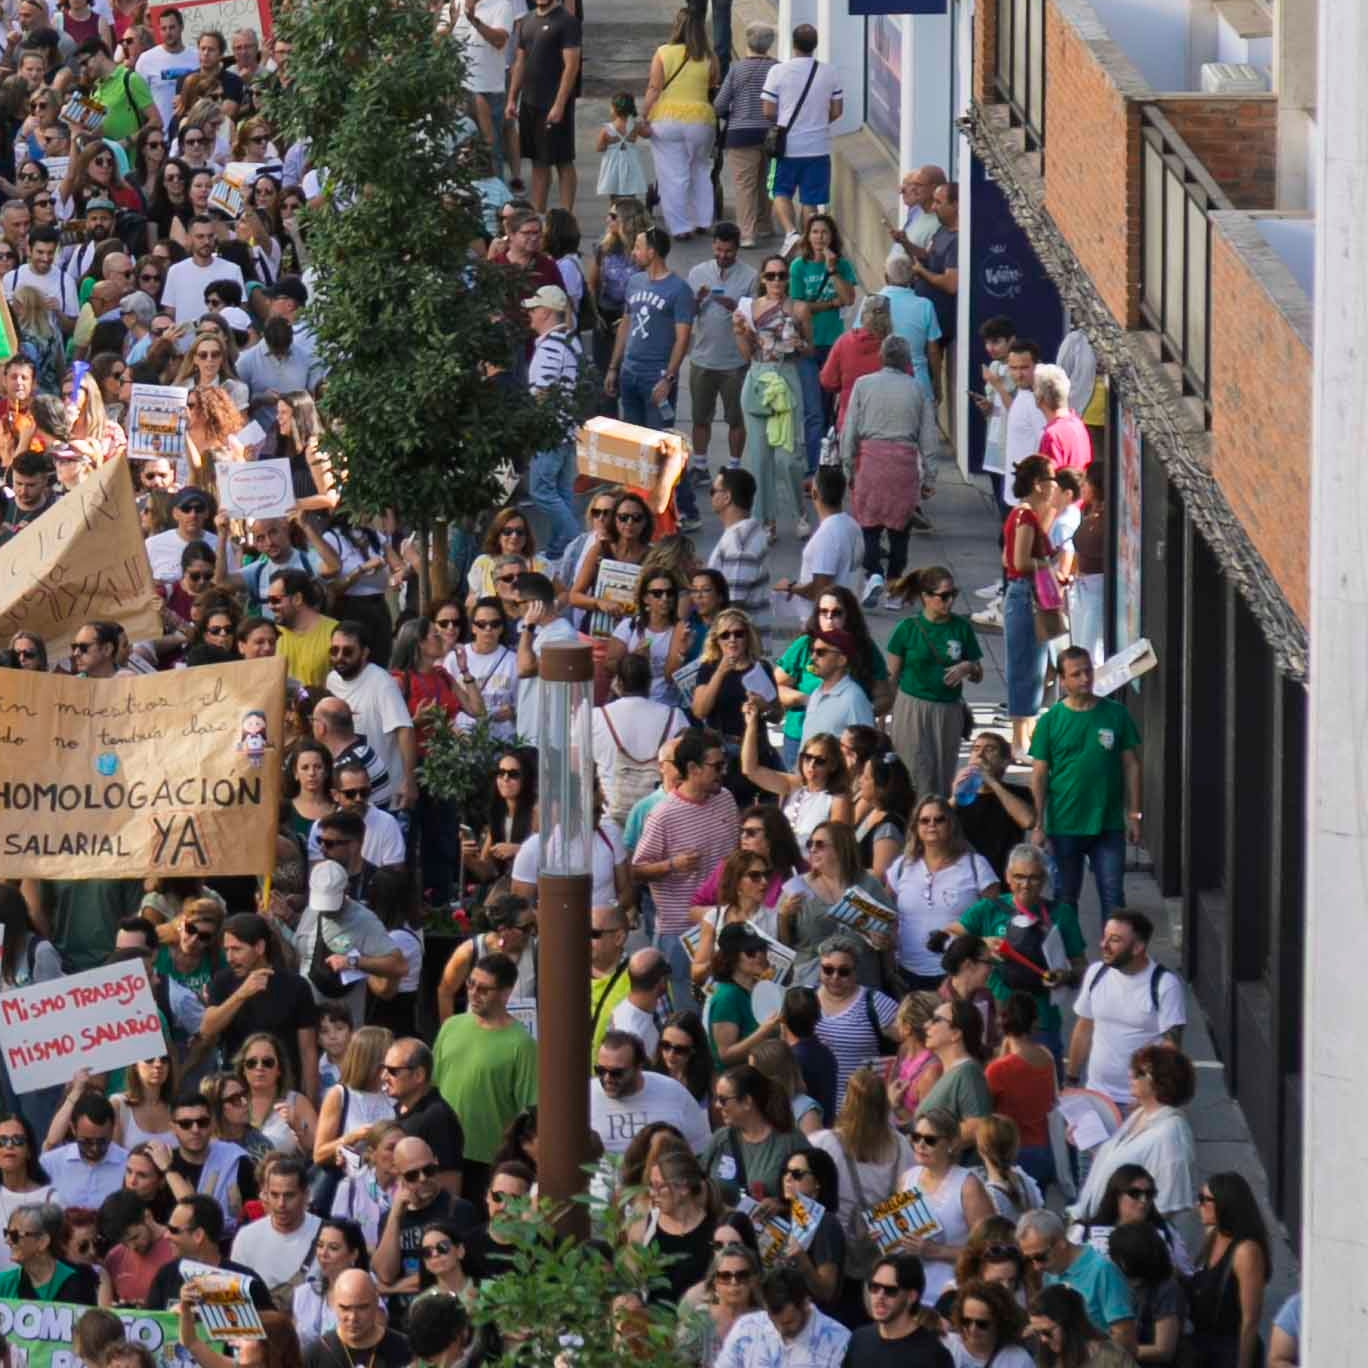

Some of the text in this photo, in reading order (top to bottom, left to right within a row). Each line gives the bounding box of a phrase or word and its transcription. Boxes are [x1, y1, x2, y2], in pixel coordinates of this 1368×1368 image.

[54, 733, 80, 750] no
[3, 813, 211, 867] SALARIAL YA
[67, 973, 146, 1008] TRABAJO
[80, 1009, 161, 1052] SALARIO
